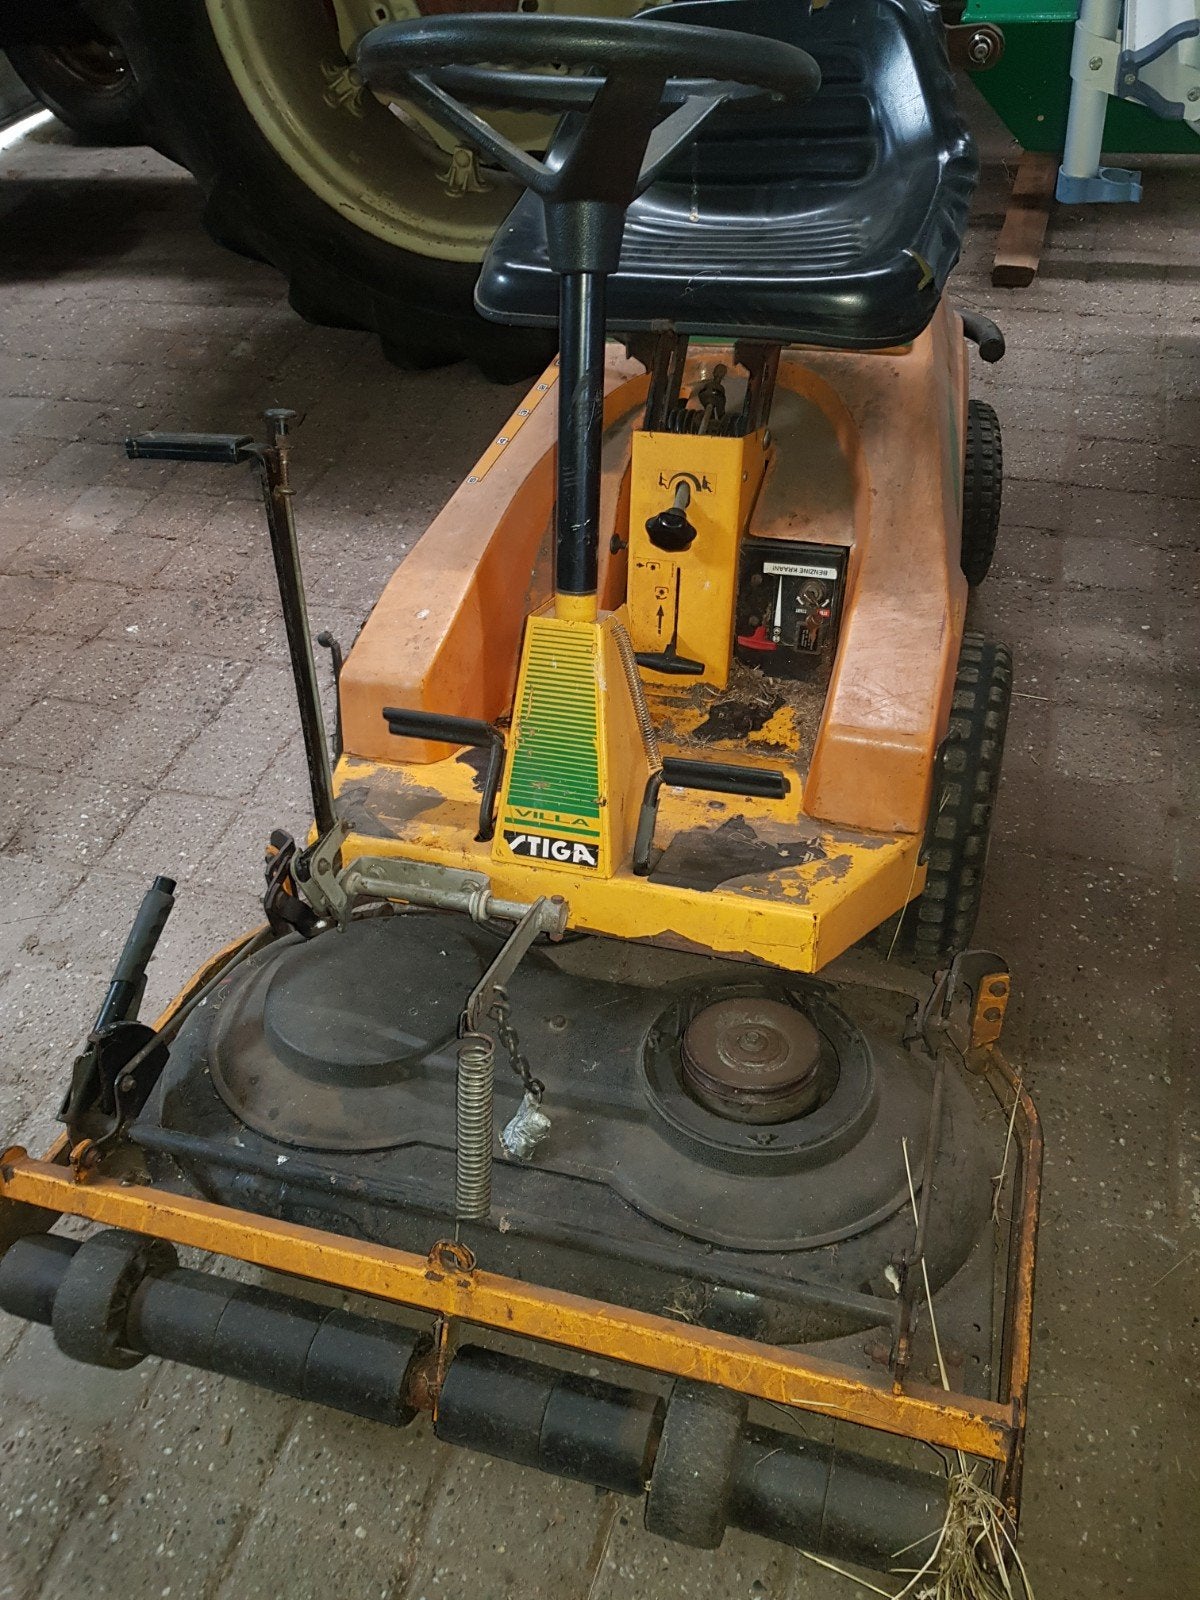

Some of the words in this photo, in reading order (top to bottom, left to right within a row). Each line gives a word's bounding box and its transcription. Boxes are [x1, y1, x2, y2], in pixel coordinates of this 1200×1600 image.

[799, 567, 828, 576] BENZINE
[515, 809, 590, 827] VILLA
[509, 835, 596, 866] STIGA
